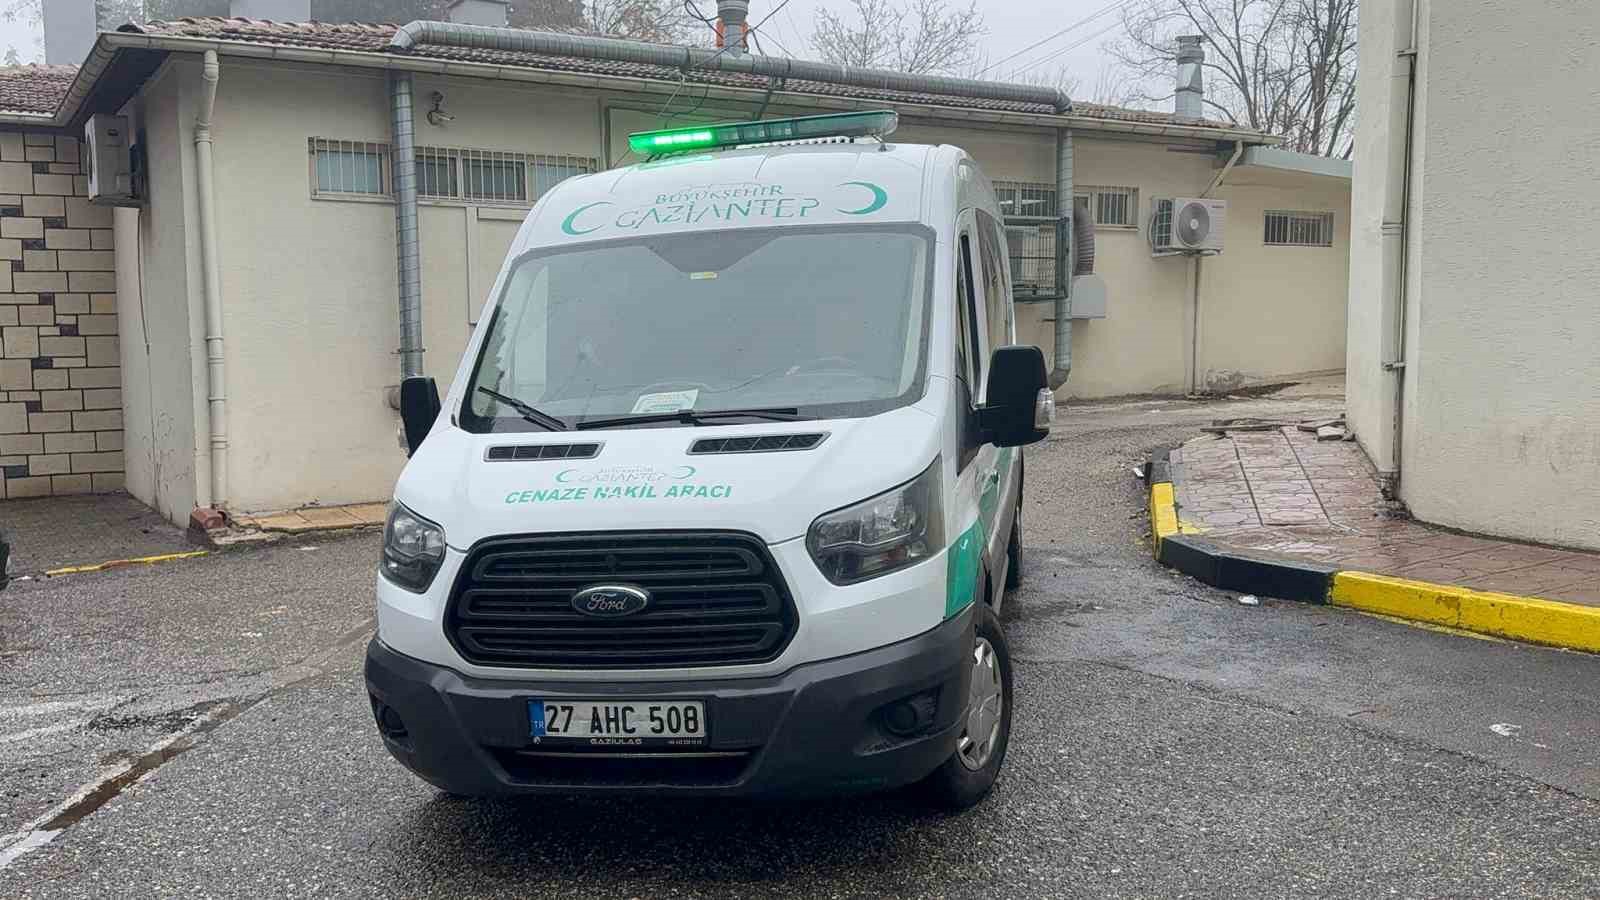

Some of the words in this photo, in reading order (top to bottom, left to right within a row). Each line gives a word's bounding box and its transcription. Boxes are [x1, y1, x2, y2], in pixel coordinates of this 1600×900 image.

[505, 487, 588, 504] CENAZE
[587, 592, 626, 610] Ford
[546, 706, 573, 733] 27
[590, 706, 635, 733] AHC
[649, 706, 698, 733] 508
